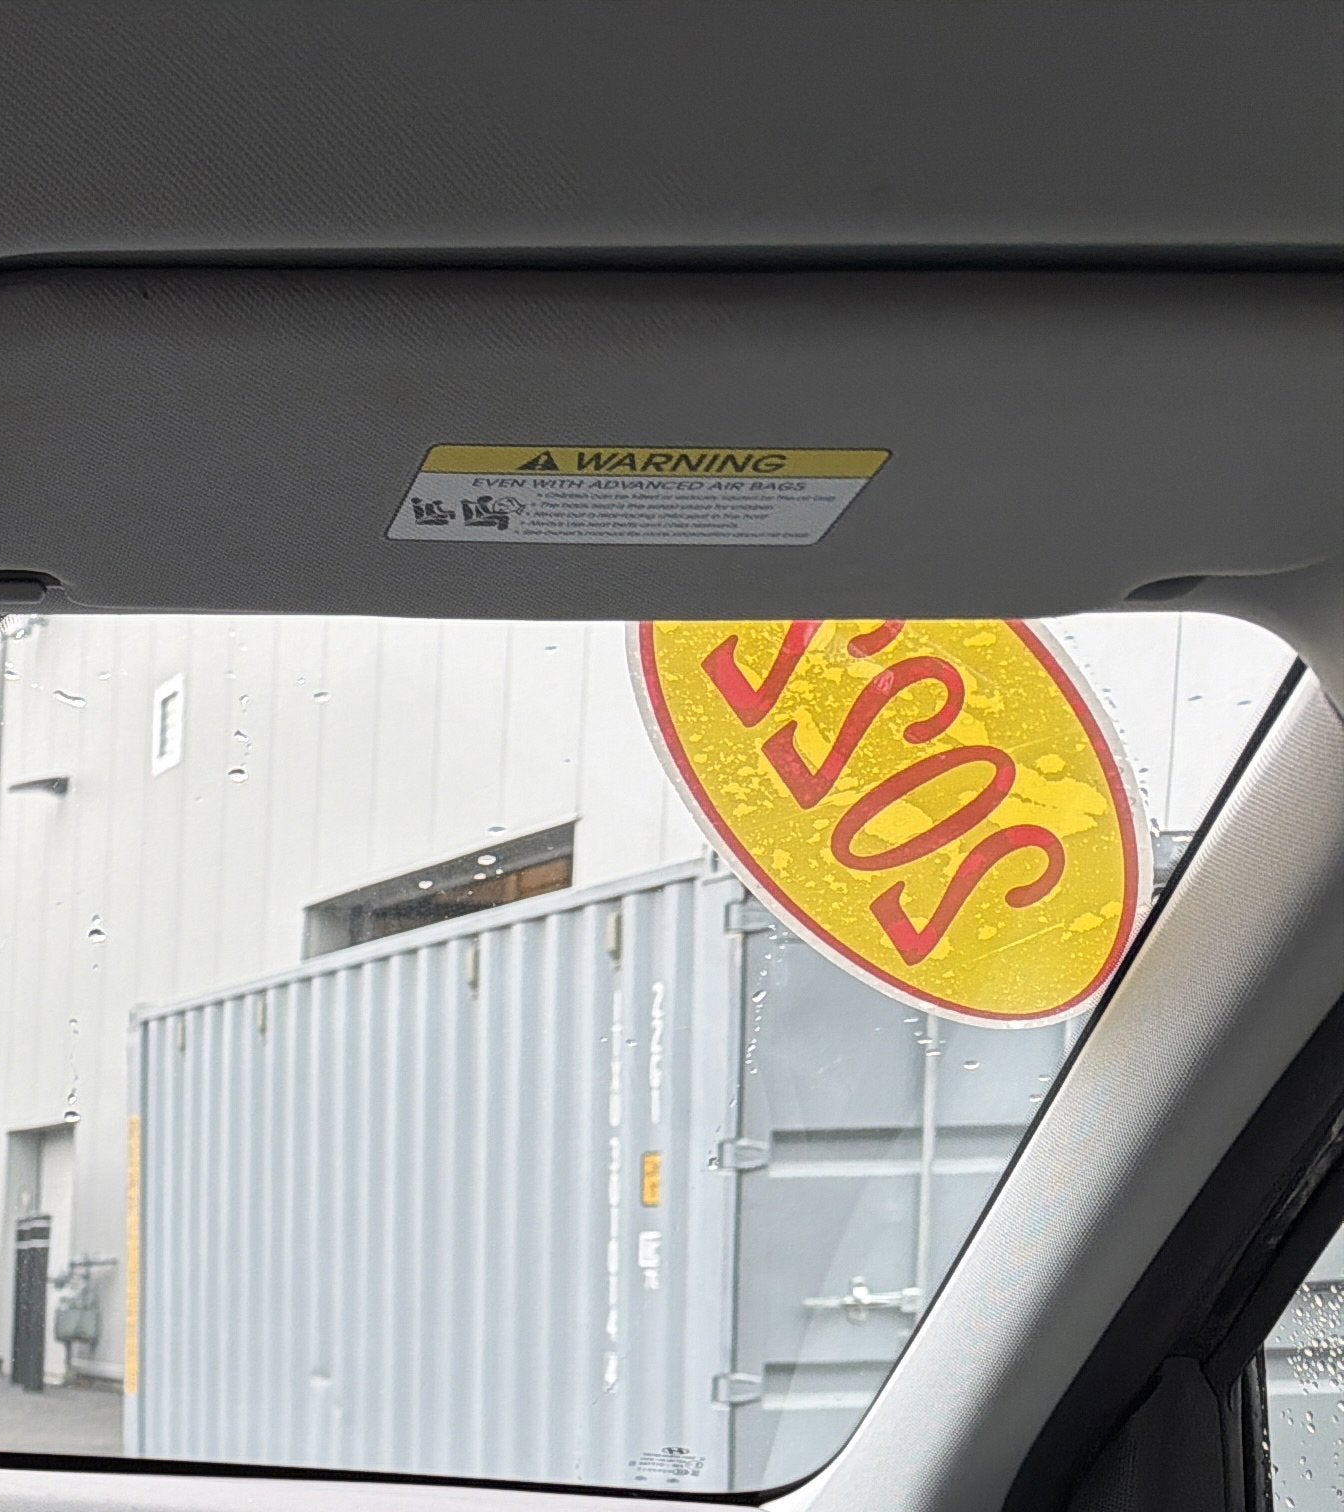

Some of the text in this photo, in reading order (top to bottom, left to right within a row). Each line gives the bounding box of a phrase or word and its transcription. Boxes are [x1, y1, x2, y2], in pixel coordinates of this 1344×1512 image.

[575, 451, 788, 474] WARNING
[472, 478, 807, 492] EVEN WITH ADVANCED AIR BAGS
